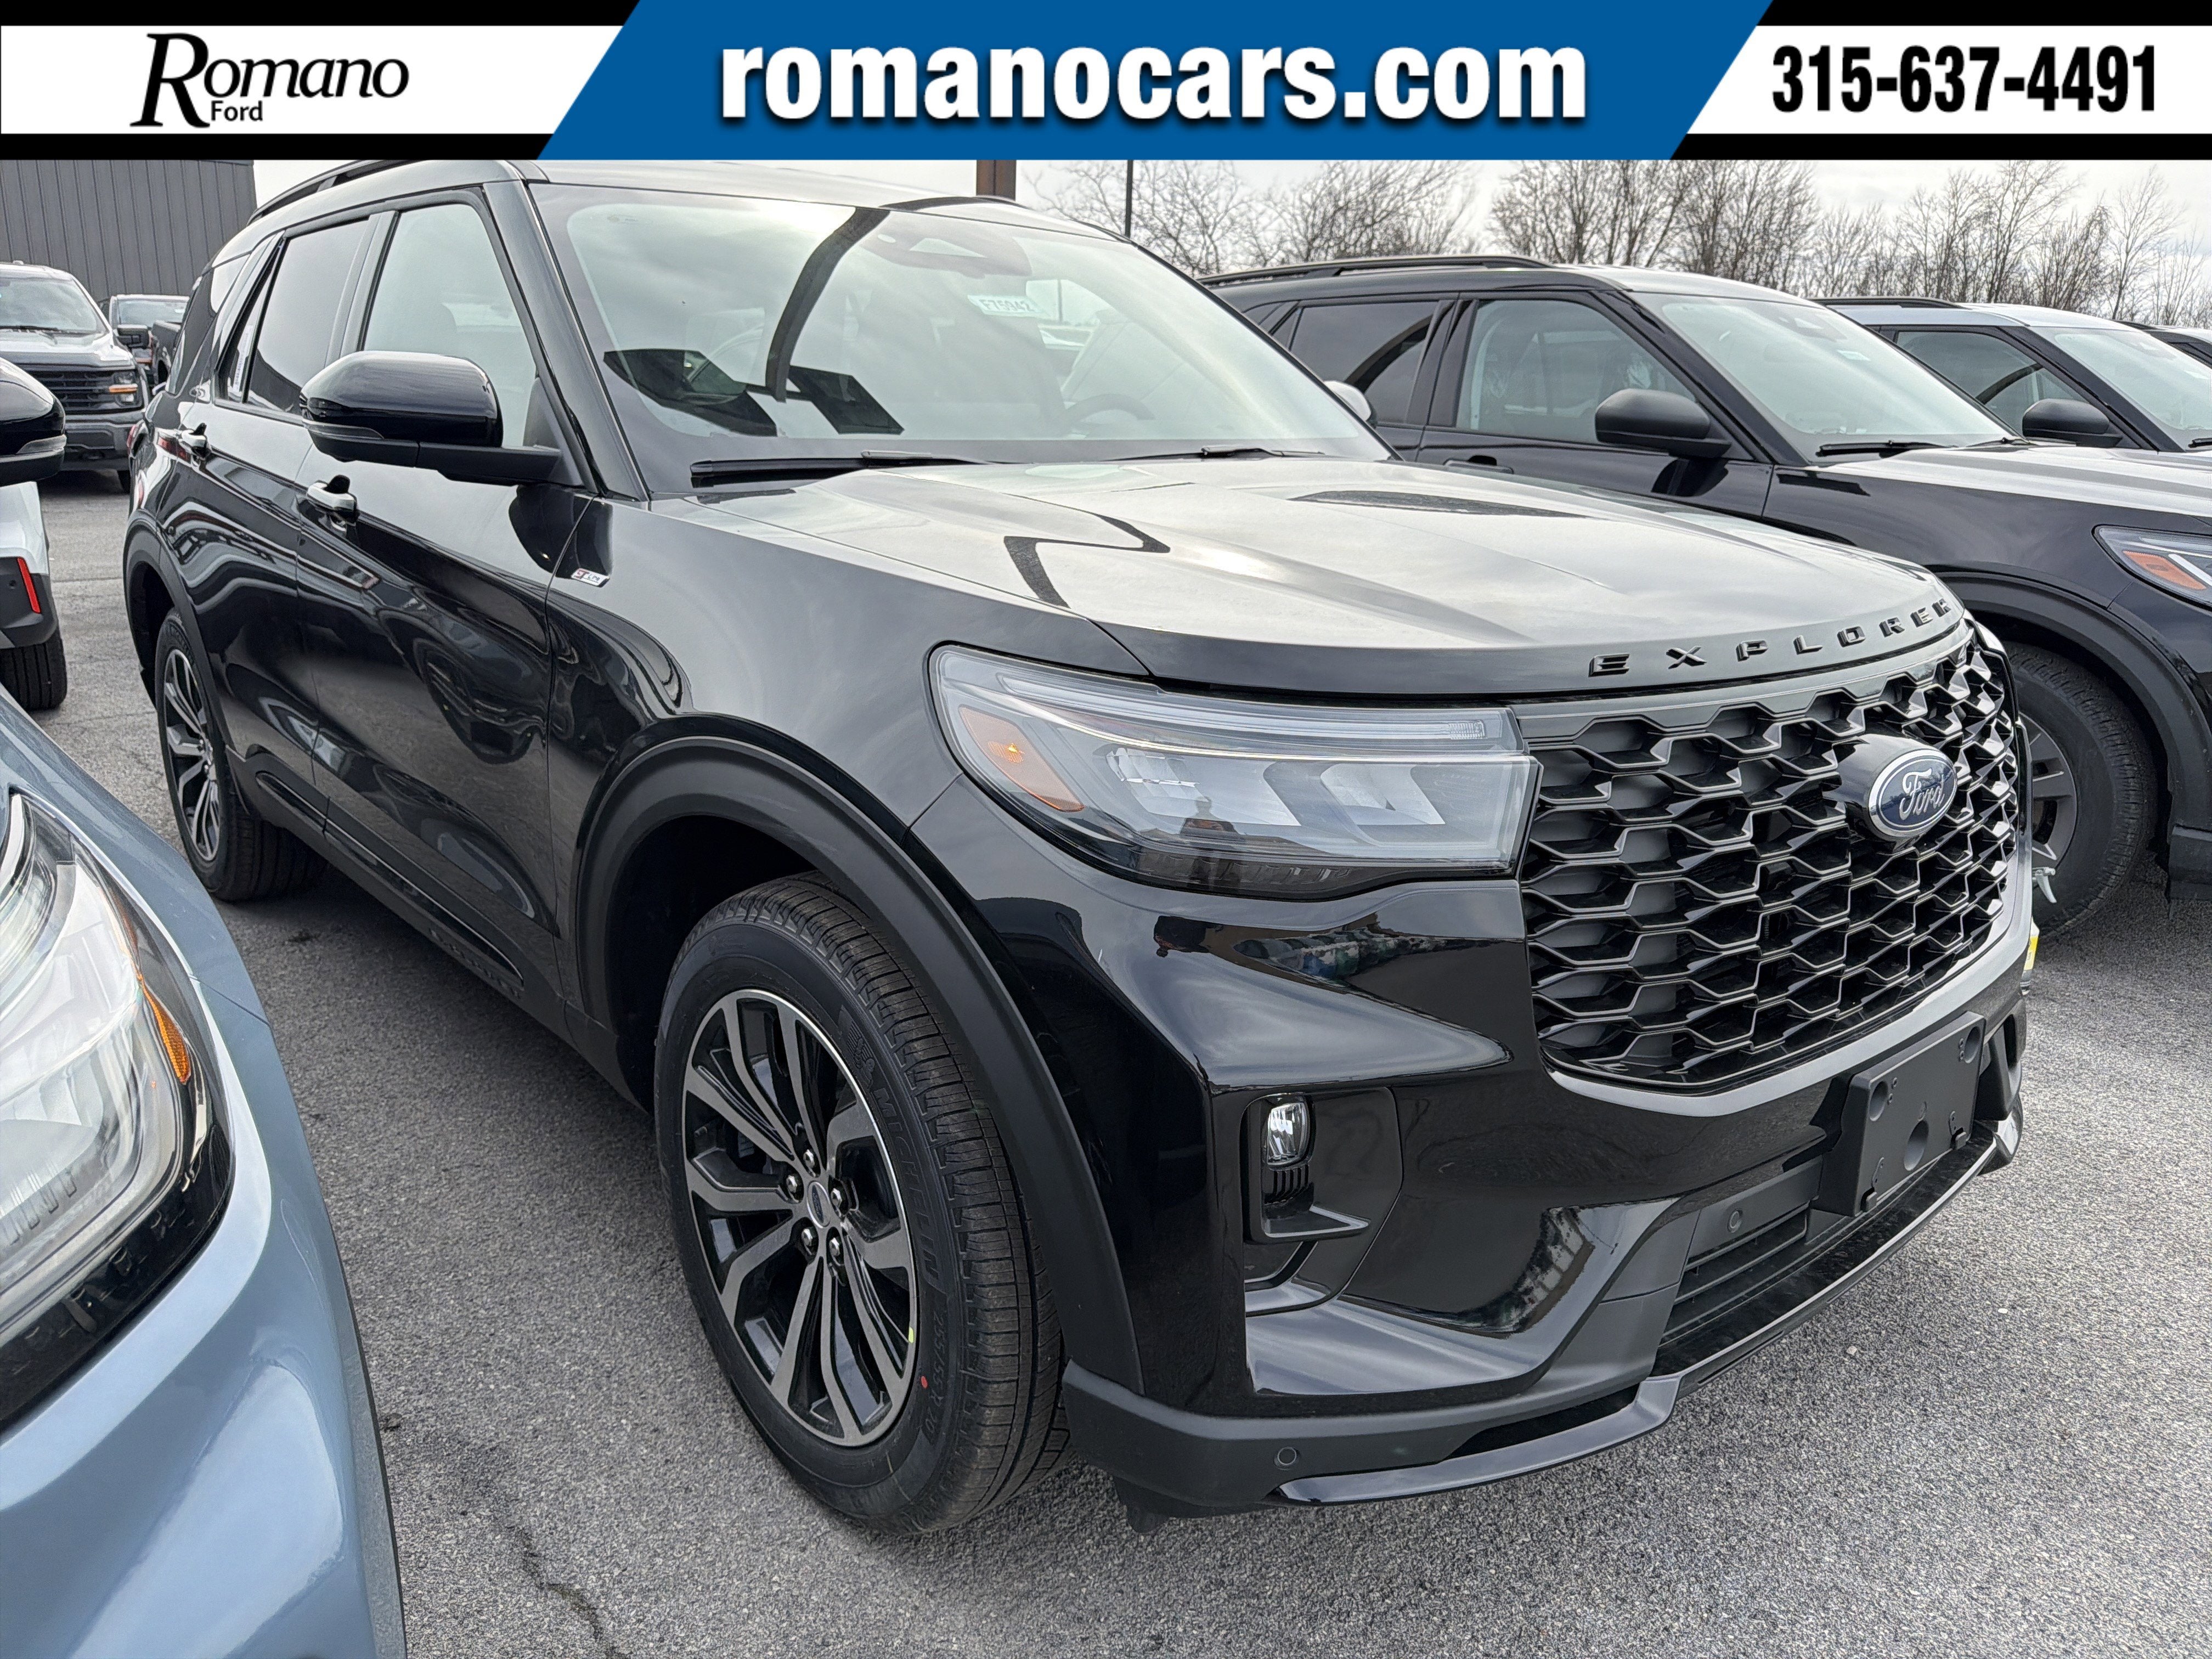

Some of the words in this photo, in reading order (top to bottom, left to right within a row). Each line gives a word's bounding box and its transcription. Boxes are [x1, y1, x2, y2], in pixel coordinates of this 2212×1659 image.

[1589, 597, 1953, 678] EXPLORER
[1899, 768, 1945, 821] Ford
[873, 1087, 939, 1281] MICHELIN
